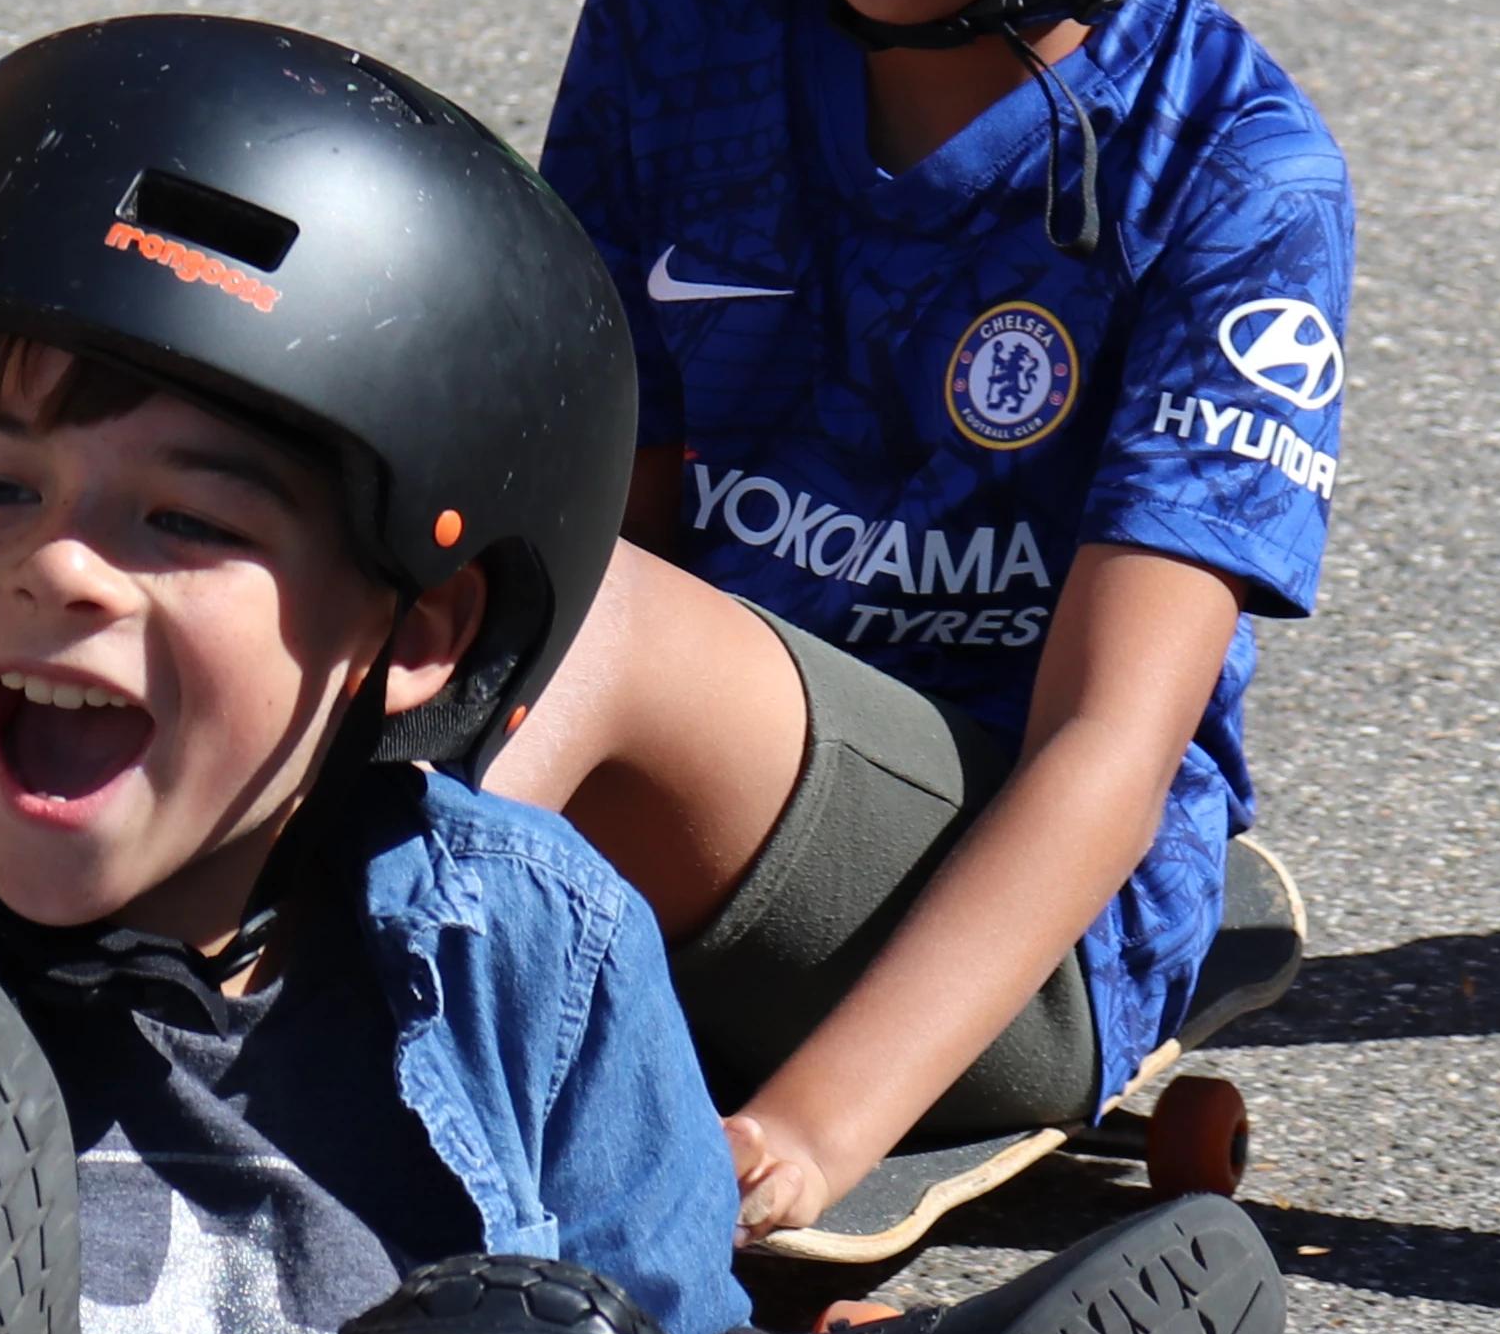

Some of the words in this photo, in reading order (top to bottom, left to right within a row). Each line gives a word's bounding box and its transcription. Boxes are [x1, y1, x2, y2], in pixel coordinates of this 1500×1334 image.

[104, 222, 282, 313] mongoose
[979, 315, 1055, 348] CHELSEA
[961, 407, 1010, 439] FOOTBALL
[1014, 416, 1044, 437] CLUB
[1153, 391, 1337, 500] HYUNDA
[693, 463, 1051, 594] YOKOAMA
[846, 603, 1050, 647] TYRES
